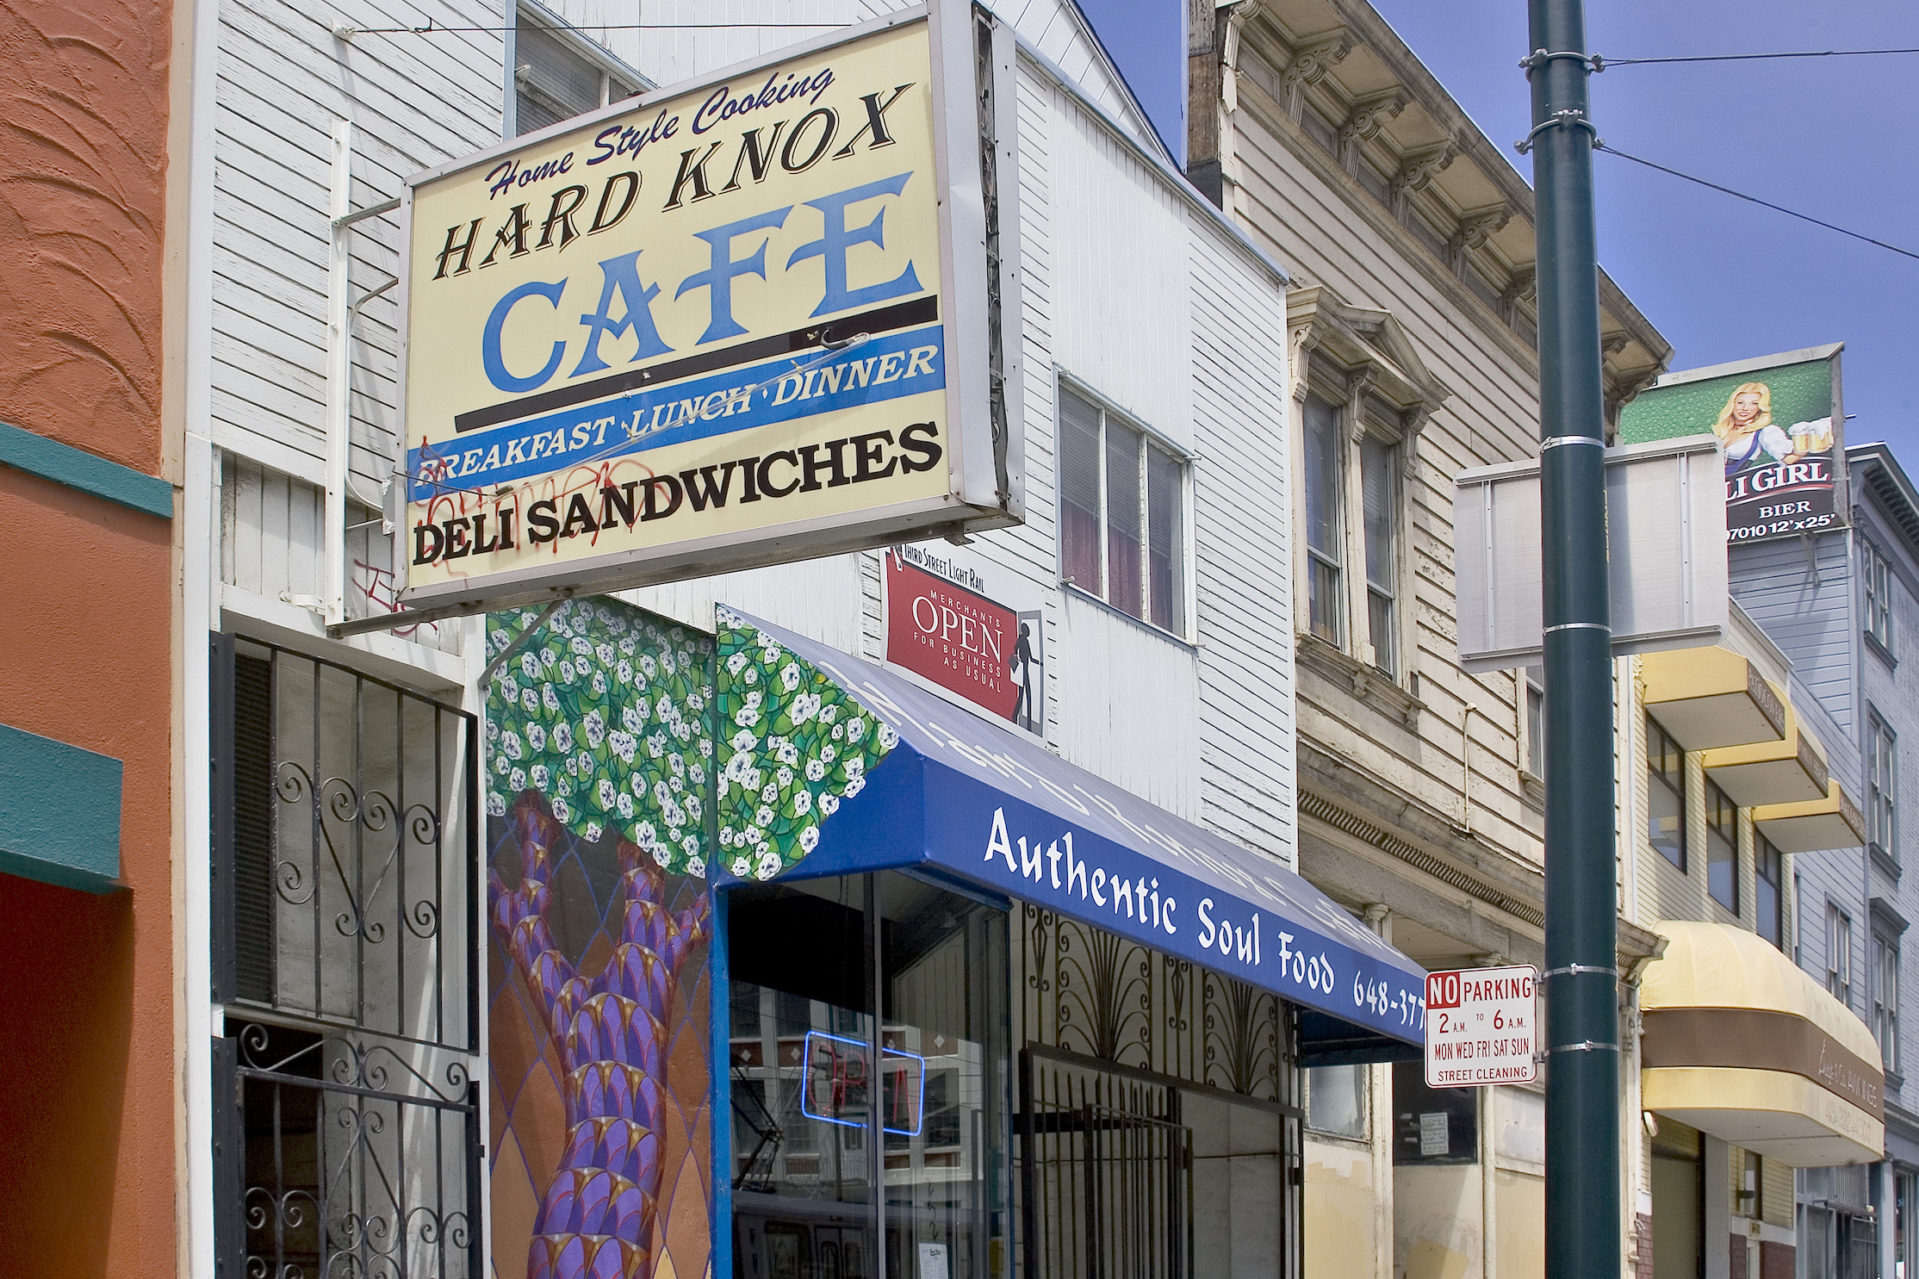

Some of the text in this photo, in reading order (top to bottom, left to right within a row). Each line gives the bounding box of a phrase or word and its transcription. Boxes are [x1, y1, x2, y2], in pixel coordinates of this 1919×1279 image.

[484, 64, 836, 200] Home Style Cooking
[431, 81, 917, 282] HARD KNOX
[481, 170, 925, 393] CAFE
[414, 344, 939, 488] BREAKFAST LUNCH DINNER
[412, 420, 943, 566] DELI SANDWICHES
[1751, 462, 1829, 492] GIRL
[1759, 500, 1812, 519] BIER
[1726, 524, 1767, 541] 7010
[923, 548, 947, 575] STREET
[948, 558, 969, 583] LIGHT
[969, 568, 985, 593] RAIL
[912, 596, 1003, 663] OPEN
[930, 589, 1001, 627] MERCHANTS
[913, 632, 1001, 678] FOR BUSINESS
[944, 657, 1001, 693] AS USUAL
[983, 806, 1177, 935] Authentic
[1197, 897, 1261, 967] Soul
[1277, 930, 1335, 995] Food
[1430, 975, 1531, 1005] NO PARKING
[1439, 1009, 1527, 1034] 2 A.M. TO 6 A.M.
[1434, 1038, 1529, 1061] MON WED FRI SAT SUN
[808, 1041, 921, 1127] OPN
[1438, 1066, 1528, 1082] STREET CLEANING
